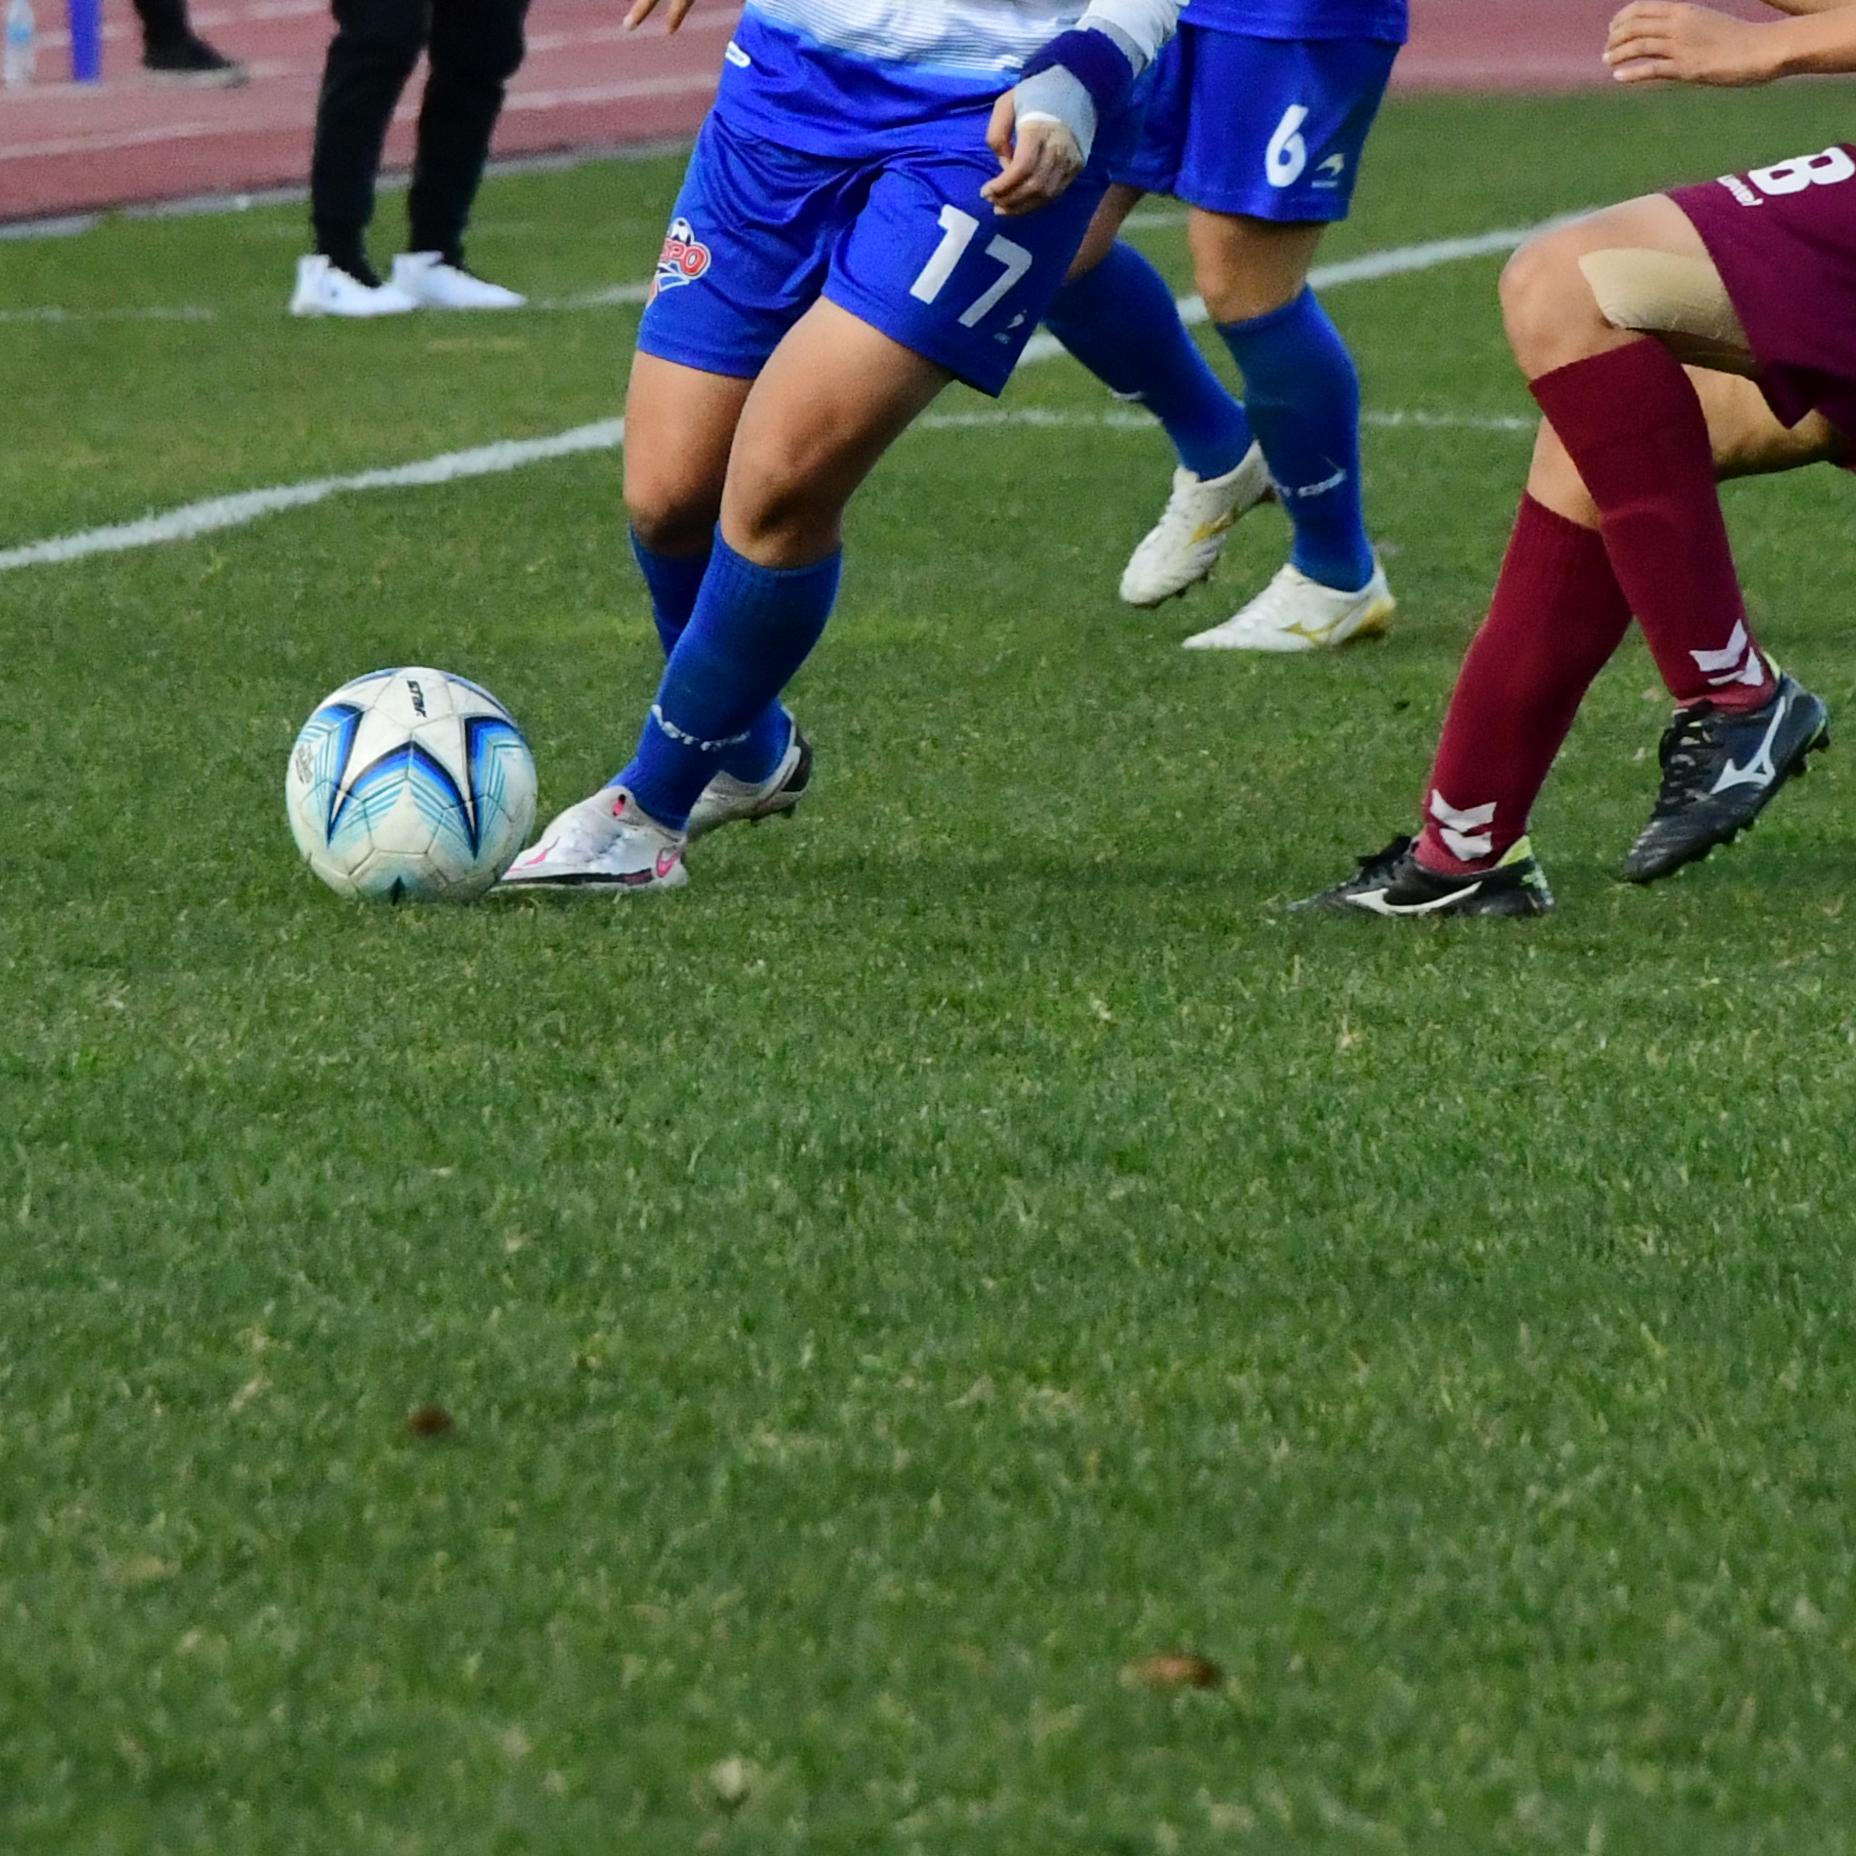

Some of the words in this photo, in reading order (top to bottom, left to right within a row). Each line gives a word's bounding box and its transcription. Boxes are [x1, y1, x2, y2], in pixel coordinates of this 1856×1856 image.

[1265, 103, 1309, 188] 6
[1747, 146, 1856, 196] 8
[909, 203, 1033, 329] 17
